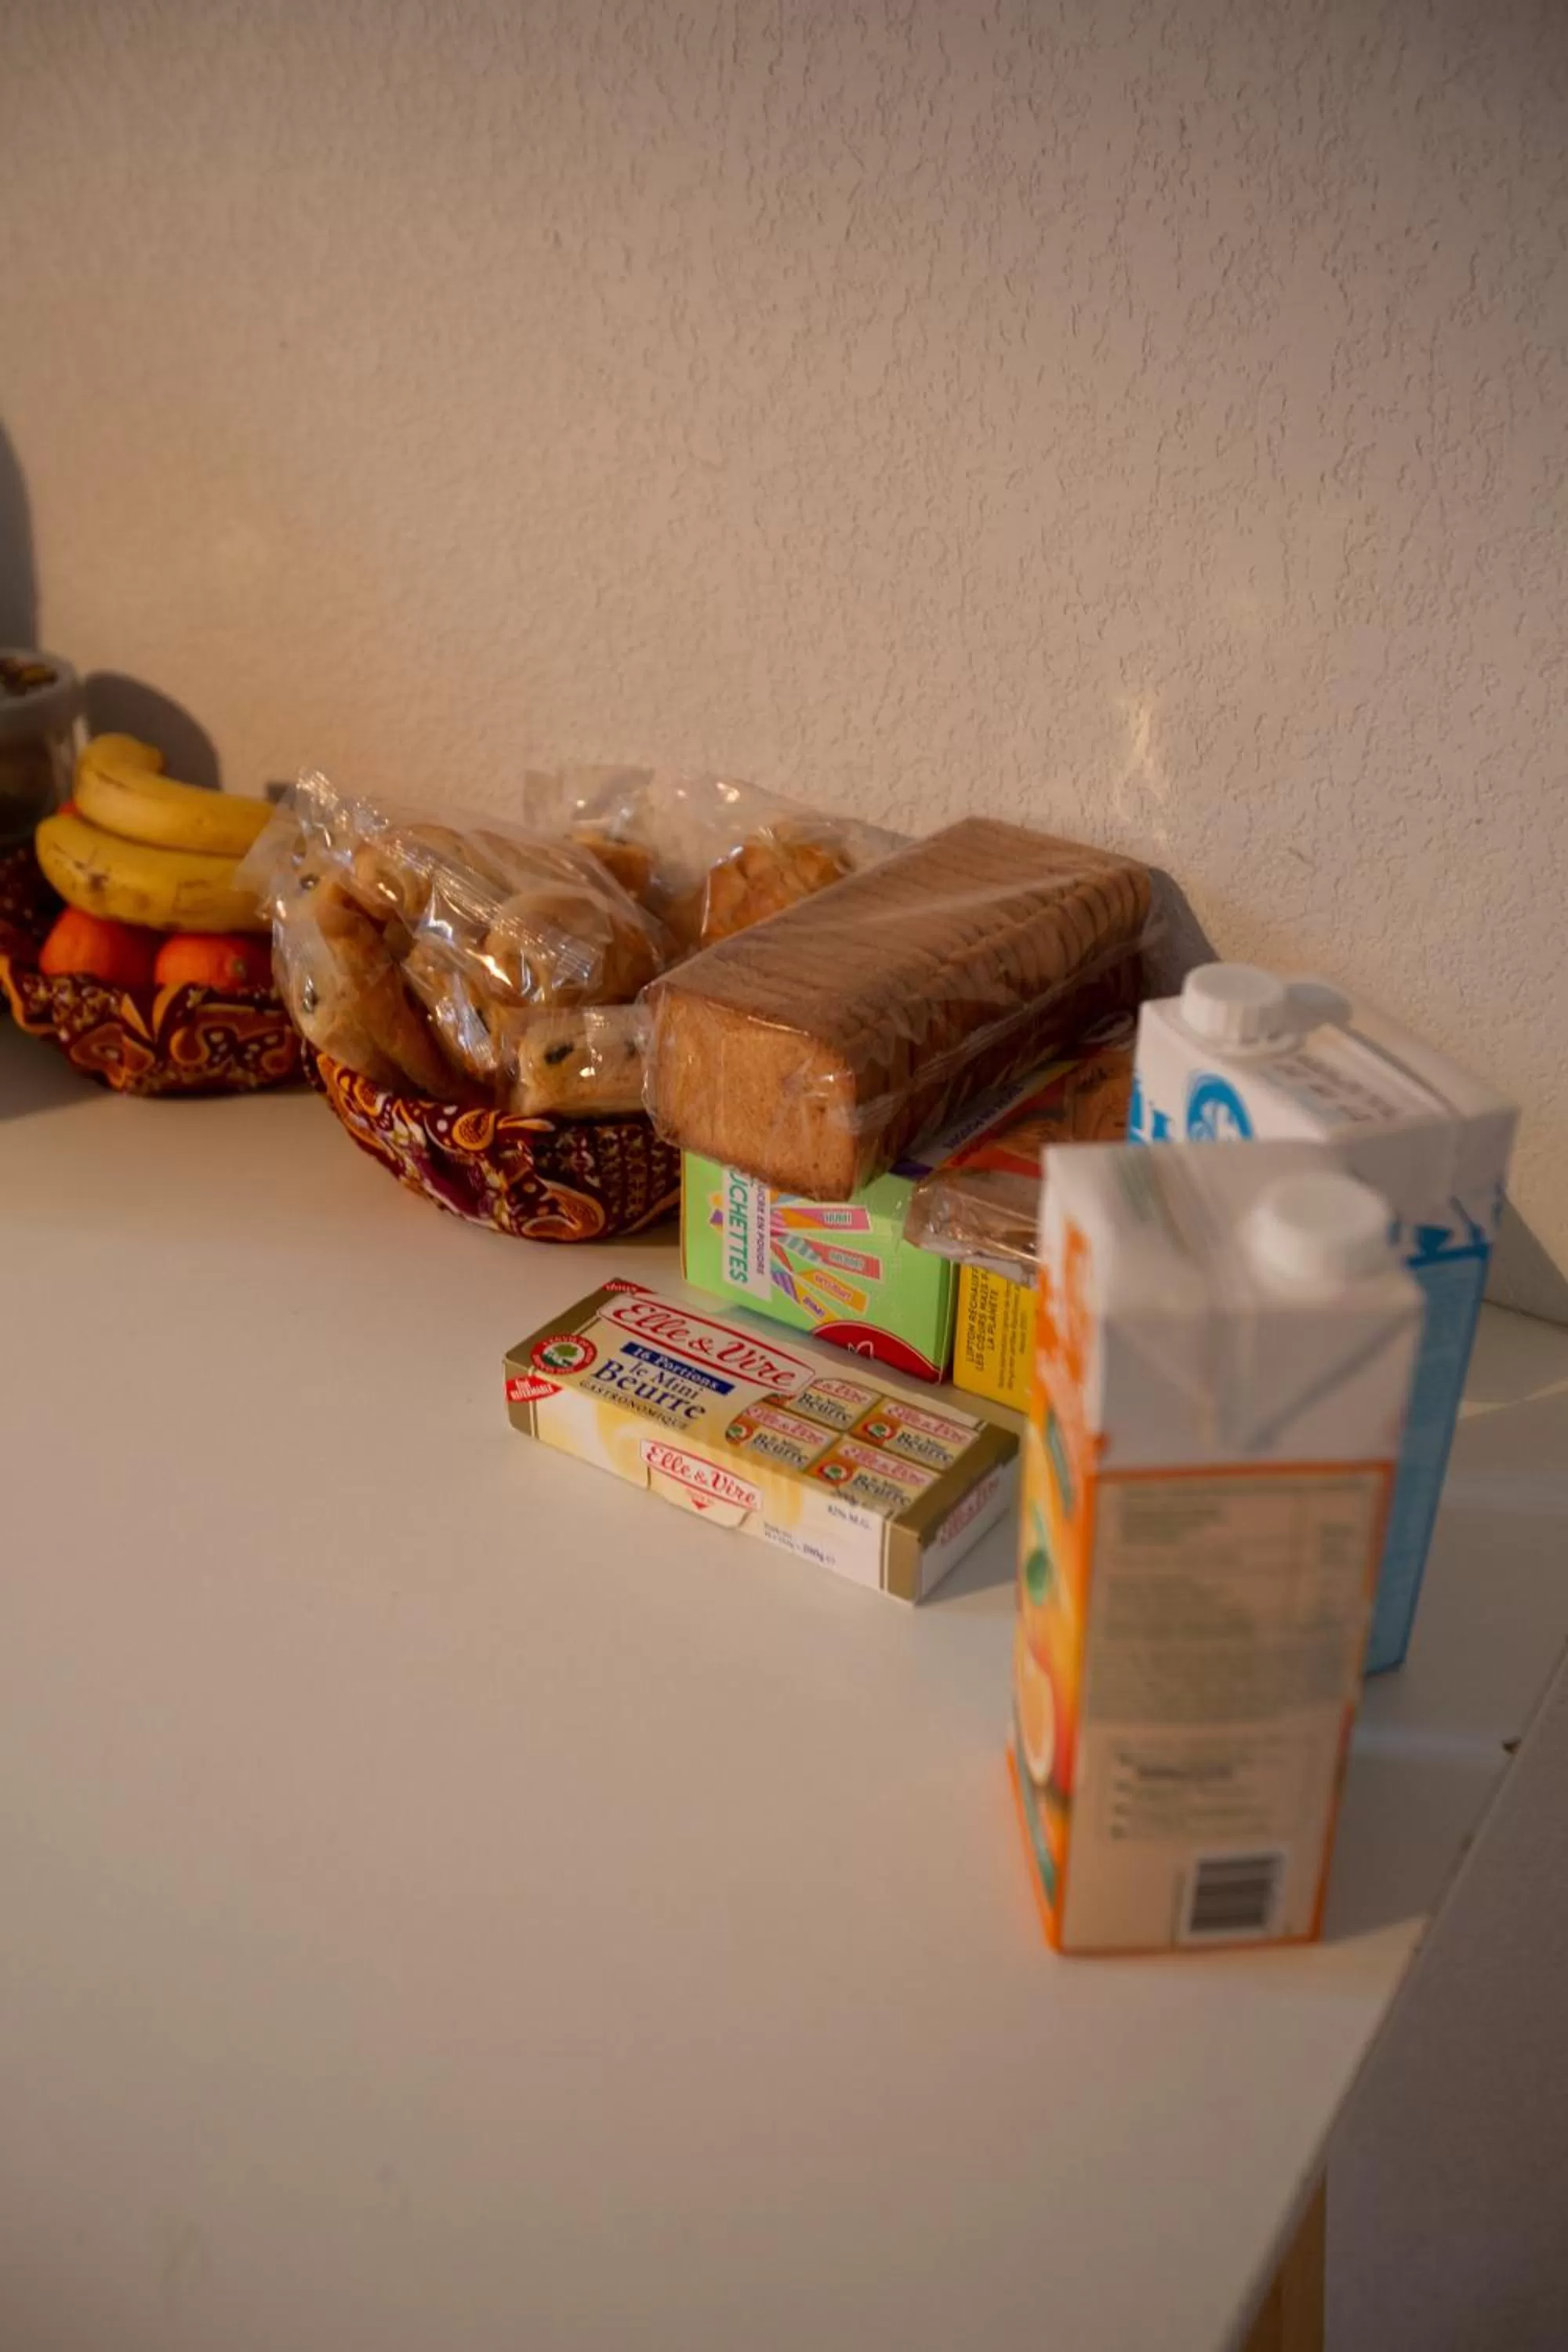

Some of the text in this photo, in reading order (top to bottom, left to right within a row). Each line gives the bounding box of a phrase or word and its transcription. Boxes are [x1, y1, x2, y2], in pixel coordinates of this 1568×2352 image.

[757, 1185, 766, 1213] UCRE
[728, 1171, 753, 1284] ÛCHETTES
[757, 1232, 766, 1276] POUDRE
[965, 1267, 979, 1363] LIPTON RÉCHAUFF
[612, 1303, 797, 1386] Elle & Vire
[975, 1352, 985, 1372] LES
[985, 1336, 995, 1352] LA
[590, 1358, 707, 1421] Beurre
[628, 1361, 704, 1400] le Mini
[632, 1347, 720, 1390] 16 Portions
[579, 1380, 689, 1430] GASTRONOMIQUE
[645, 1445, 757, 1504] Elle & Vire
